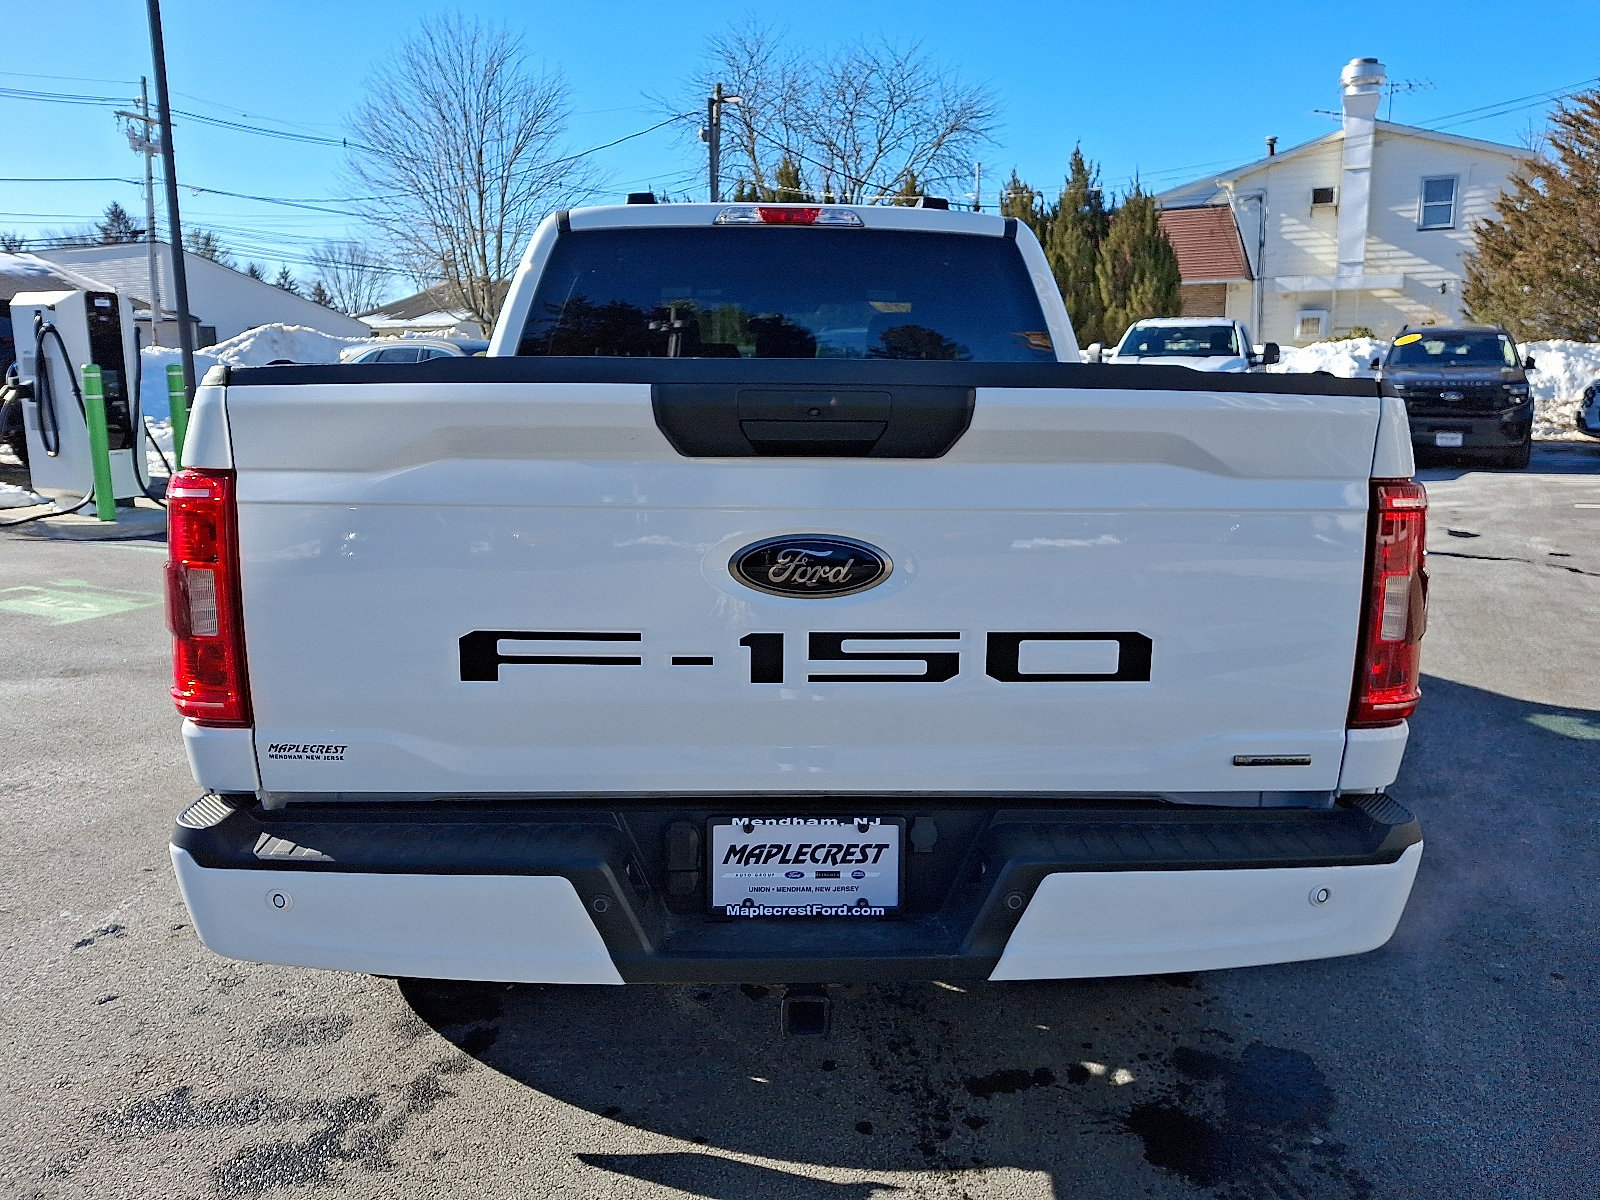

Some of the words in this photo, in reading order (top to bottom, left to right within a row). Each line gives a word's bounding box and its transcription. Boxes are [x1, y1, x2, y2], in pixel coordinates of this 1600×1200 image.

[768, 548, 855, 583] Ford
[458, 630, 1153, 684] F-150
[268, 743, 348, 755] MAPLECREST
[731, 817, 845, 827] Mendham,
[853, 817, 881, 826] NJ
[722, 843, 890, 867] MAPLECREST
[726, 904, 885, 918] MaplecrestFord.com
